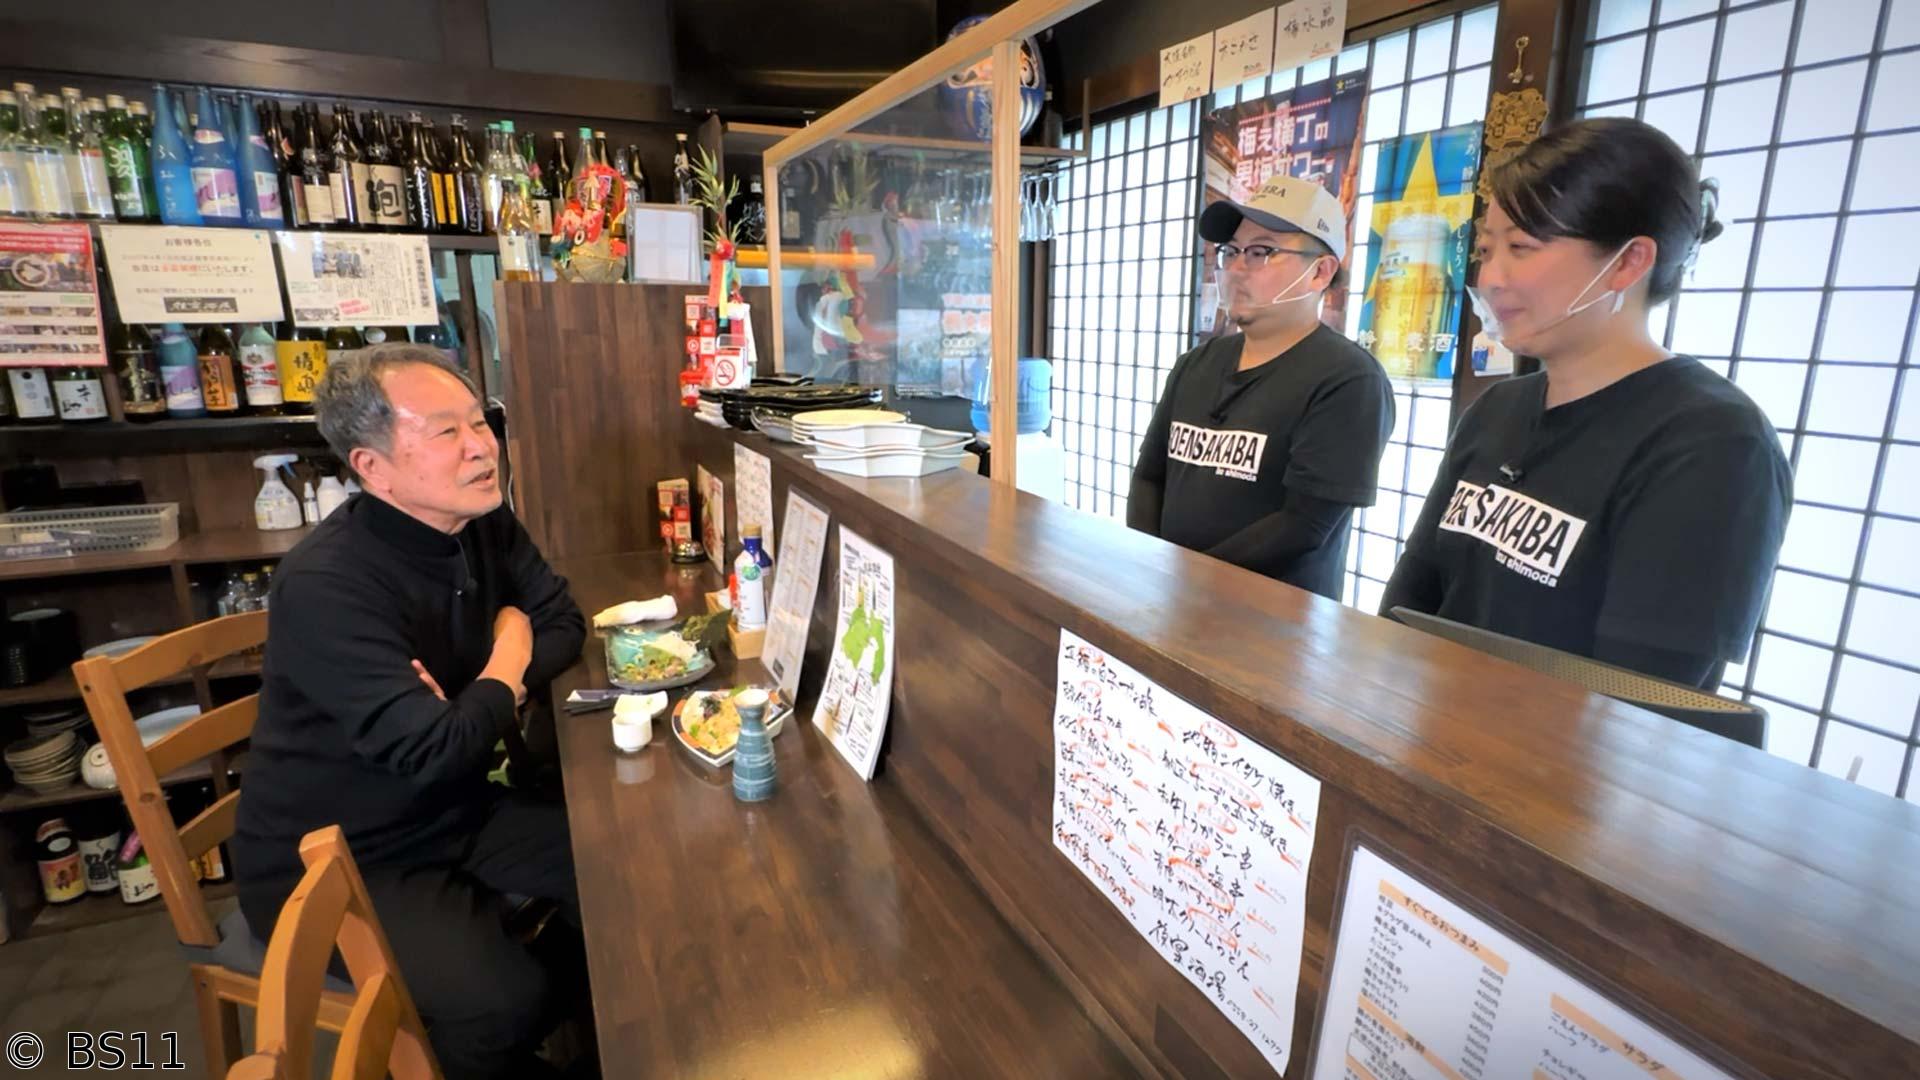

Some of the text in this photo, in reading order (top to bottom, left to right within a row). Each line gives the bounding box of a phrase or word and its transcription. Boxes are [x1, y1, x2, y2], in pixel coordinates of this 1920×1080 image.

[1506, 556, 1558, 588] shimoda
[1623, 1041, 1665, 1071] サラダ
